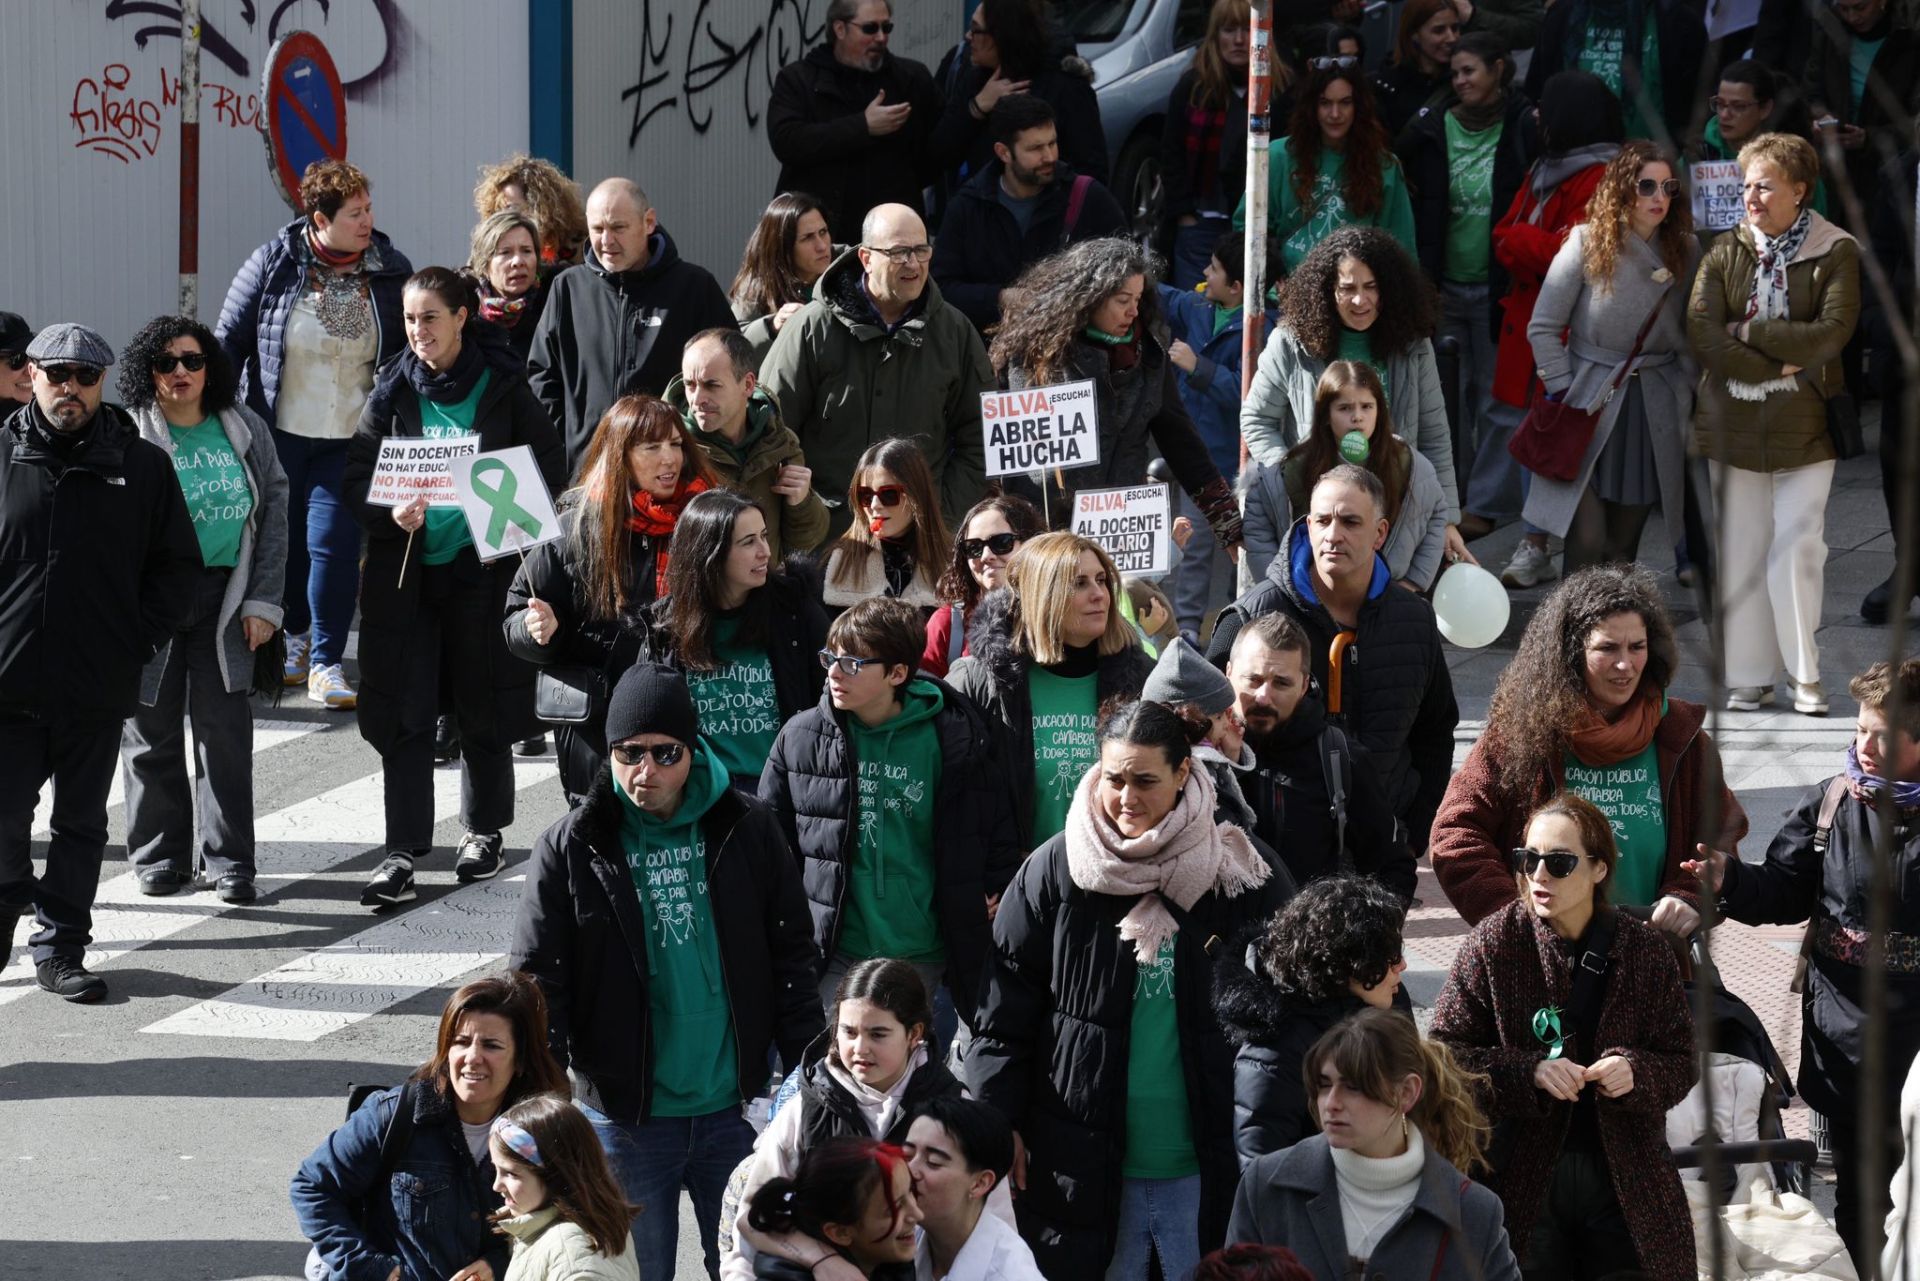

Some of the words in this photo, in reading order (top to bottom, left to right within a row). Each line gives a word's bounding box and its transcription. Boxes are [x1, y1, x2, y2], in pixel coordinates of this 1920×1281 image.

[1696, 184, 1712, 199] AL
[1717, 183, 1745, 197] DOC
[1709, 198, 1745, 212] SALA
[1708, 212, 1743, 226] DECE
[983, 391, 1055, 419] SILVA,
[1049, 389, 1091, 405] ¡ESCUCHA!
[990, 417, 1051, 447] ABRE
[1058, 412, 1087, 438] LA
[173, 452, 204, 472] UELA
[206, 449, 241, 469] PÚBL
[381, 447, 405, 460] SIN
[409, 444, 475, 460] DOCENTES
[1000, 438, 1081, 470] HUCHA
[378, 463, 393, 472] NO
[395, 463, 417, 473] HAY
[418, 463, 451, 473] EDUCA
[375, 476, 394, 487] NO
[371, 490, 380, 500] SI
[381, 491, 396, 500] NO
[397, 491, 416, 502] HAY
[1124, 487, 1164, 504] ¡ESCUCHA!
[1077, 520, 1096, 537] AL
[1101, 514, 1162, 535] DOCENTE
[1112, 552, 1150, 570] ENTE
[738, 664, 775, 683] PÚBLIC
[701, 719, 730, 736] ARA
[1032, 713, 1078, 731] DUCACIÓN
[1607, 768, 1648, 787] PÚBLICA
